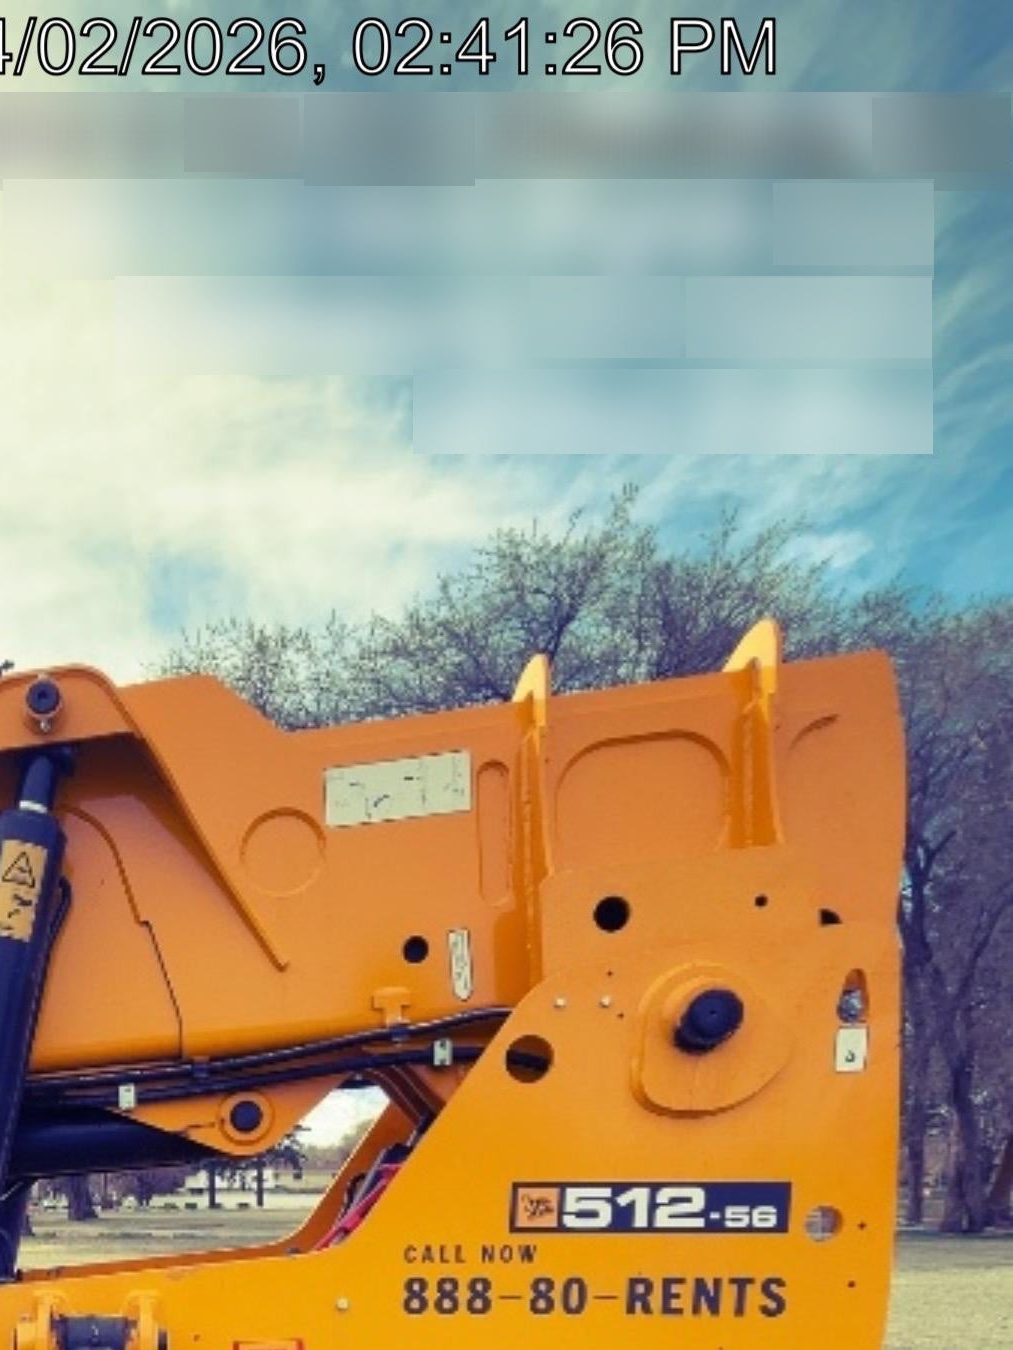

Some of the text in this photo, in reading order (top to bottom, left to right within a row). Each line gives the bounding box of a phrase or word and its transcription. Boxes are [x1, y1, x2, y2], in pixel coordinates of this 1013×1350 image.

[403, 1244, 539, 1265] CALL NOW
[403, 1276, 787, 1319] 888-80-RENTS
